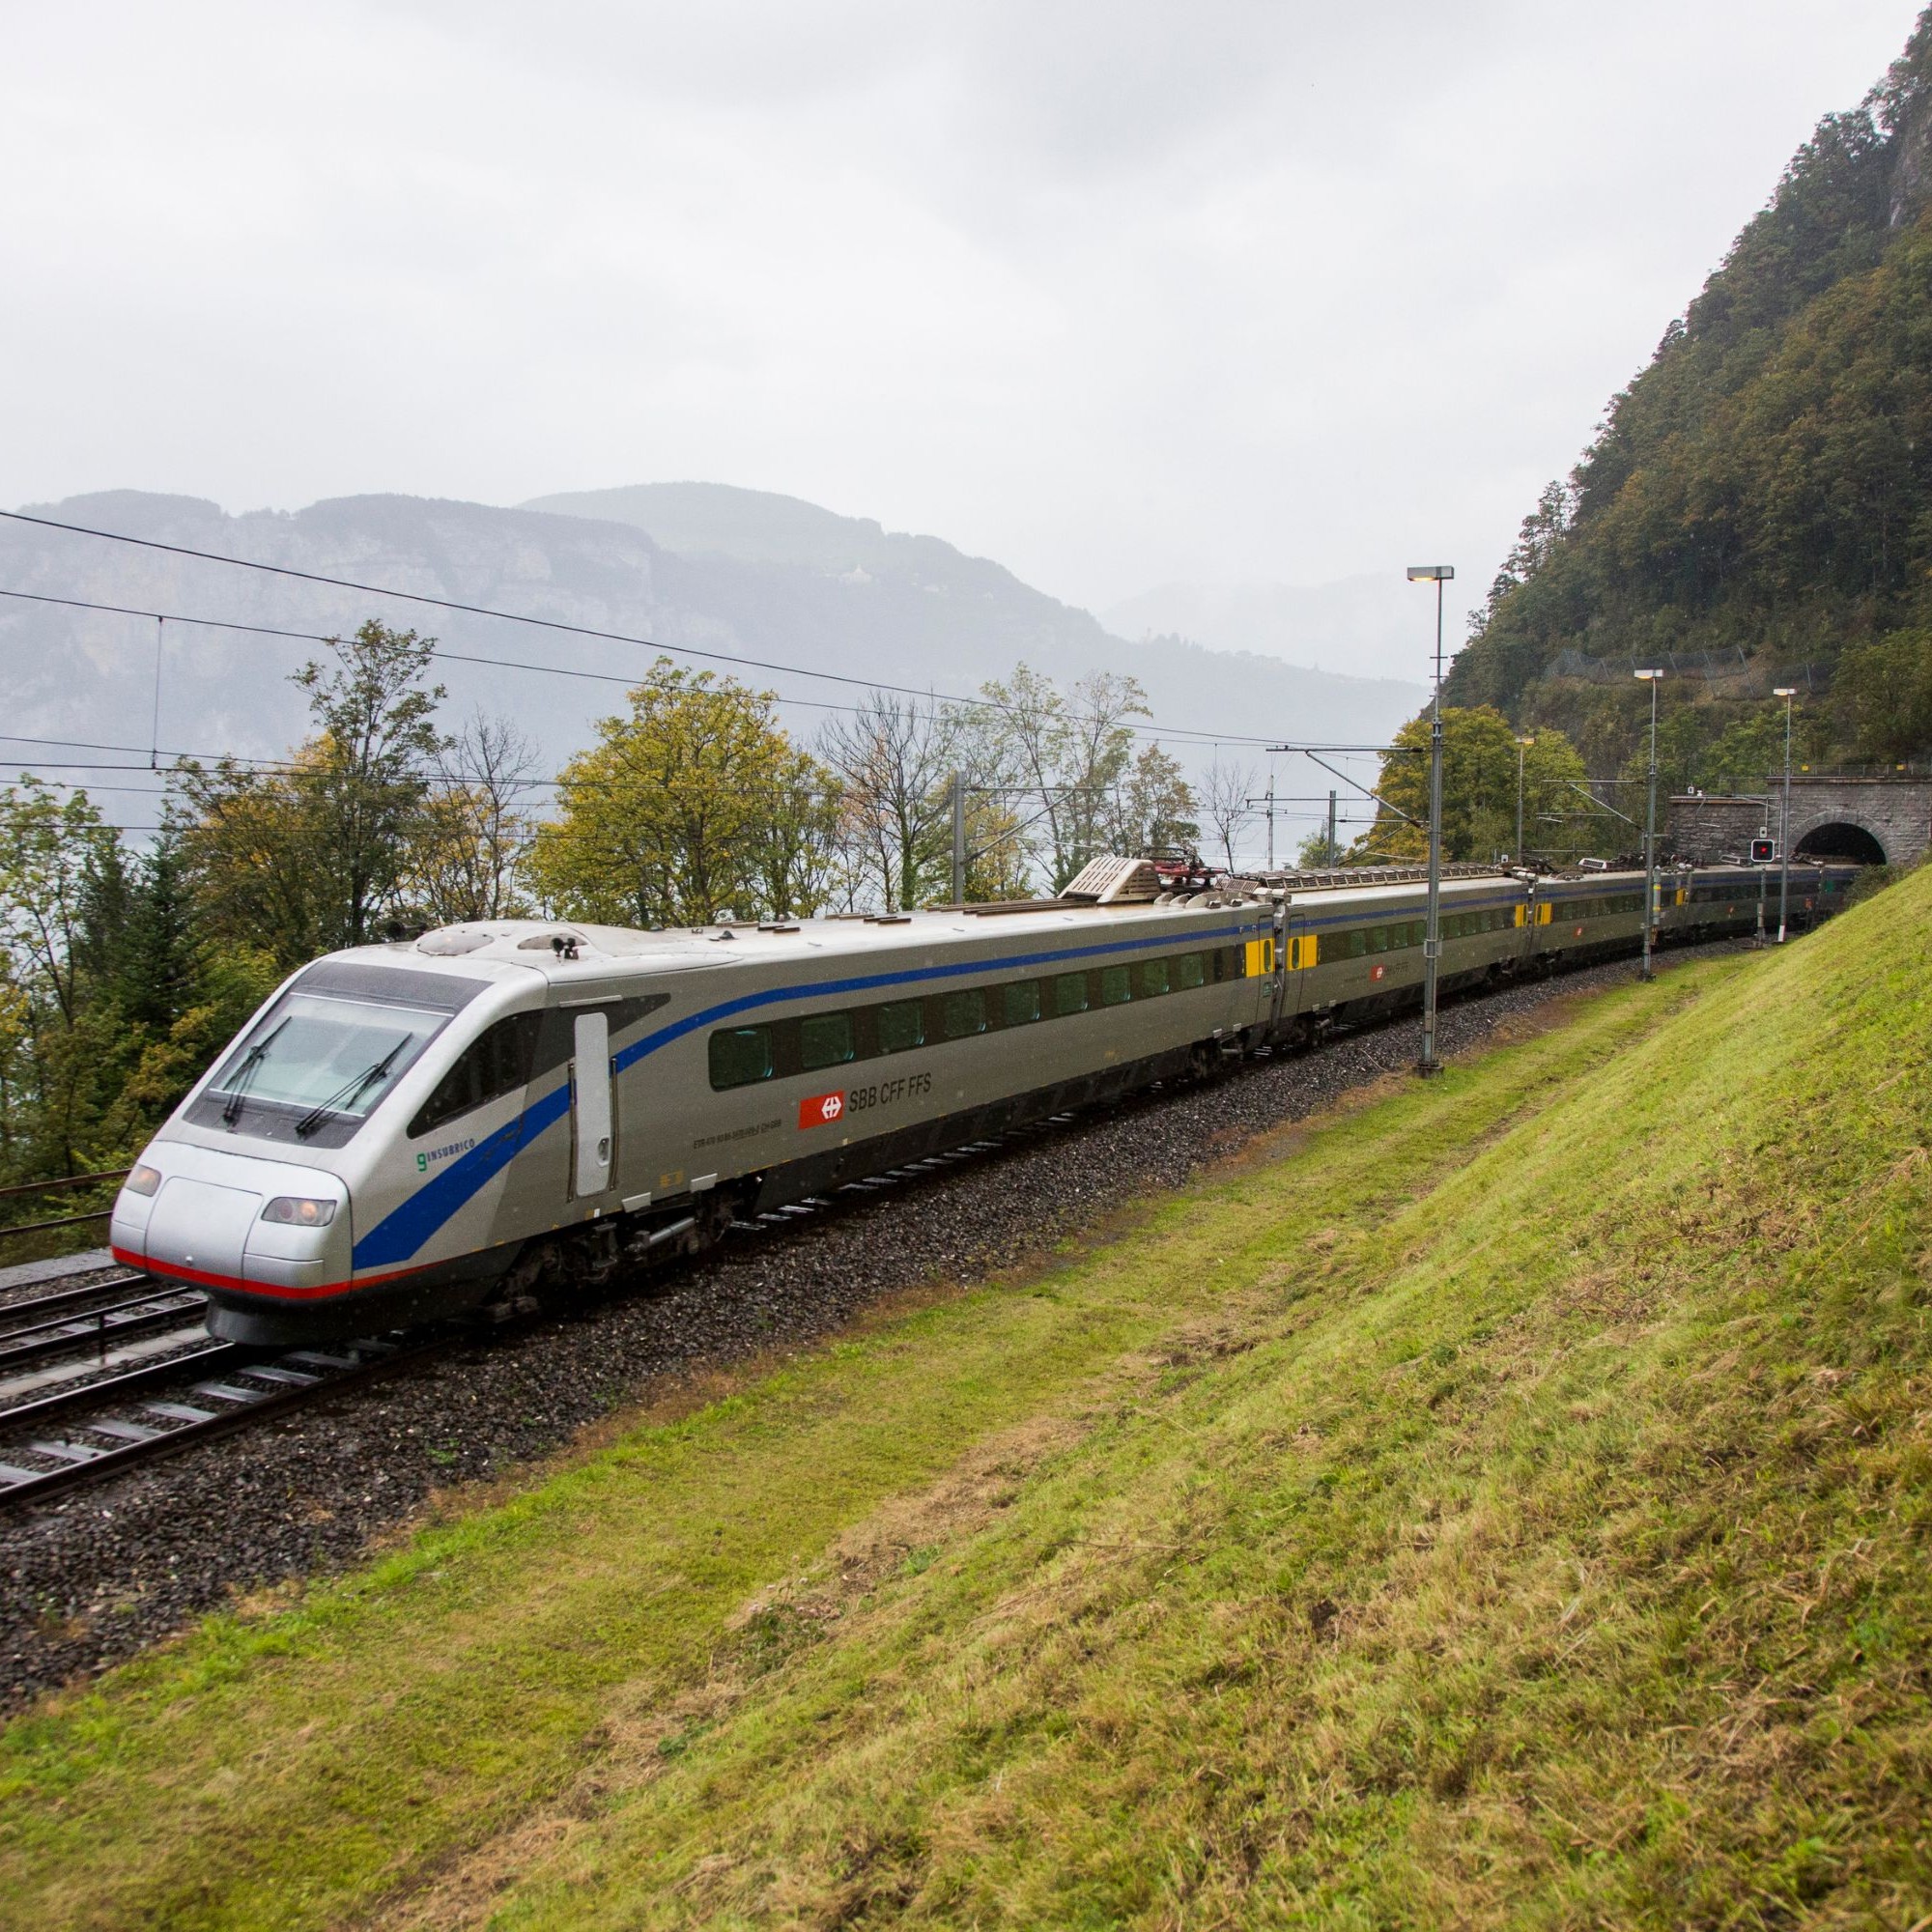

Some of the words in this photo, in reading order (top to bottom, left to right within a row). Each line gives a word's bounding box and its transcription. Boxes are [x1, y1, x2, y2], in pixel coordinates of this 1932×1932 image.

[849, 1087, 877, 1112] SBB
[880, 1079, 905, 1104] CFF
[908, 1072, 931, 1097] FFS
